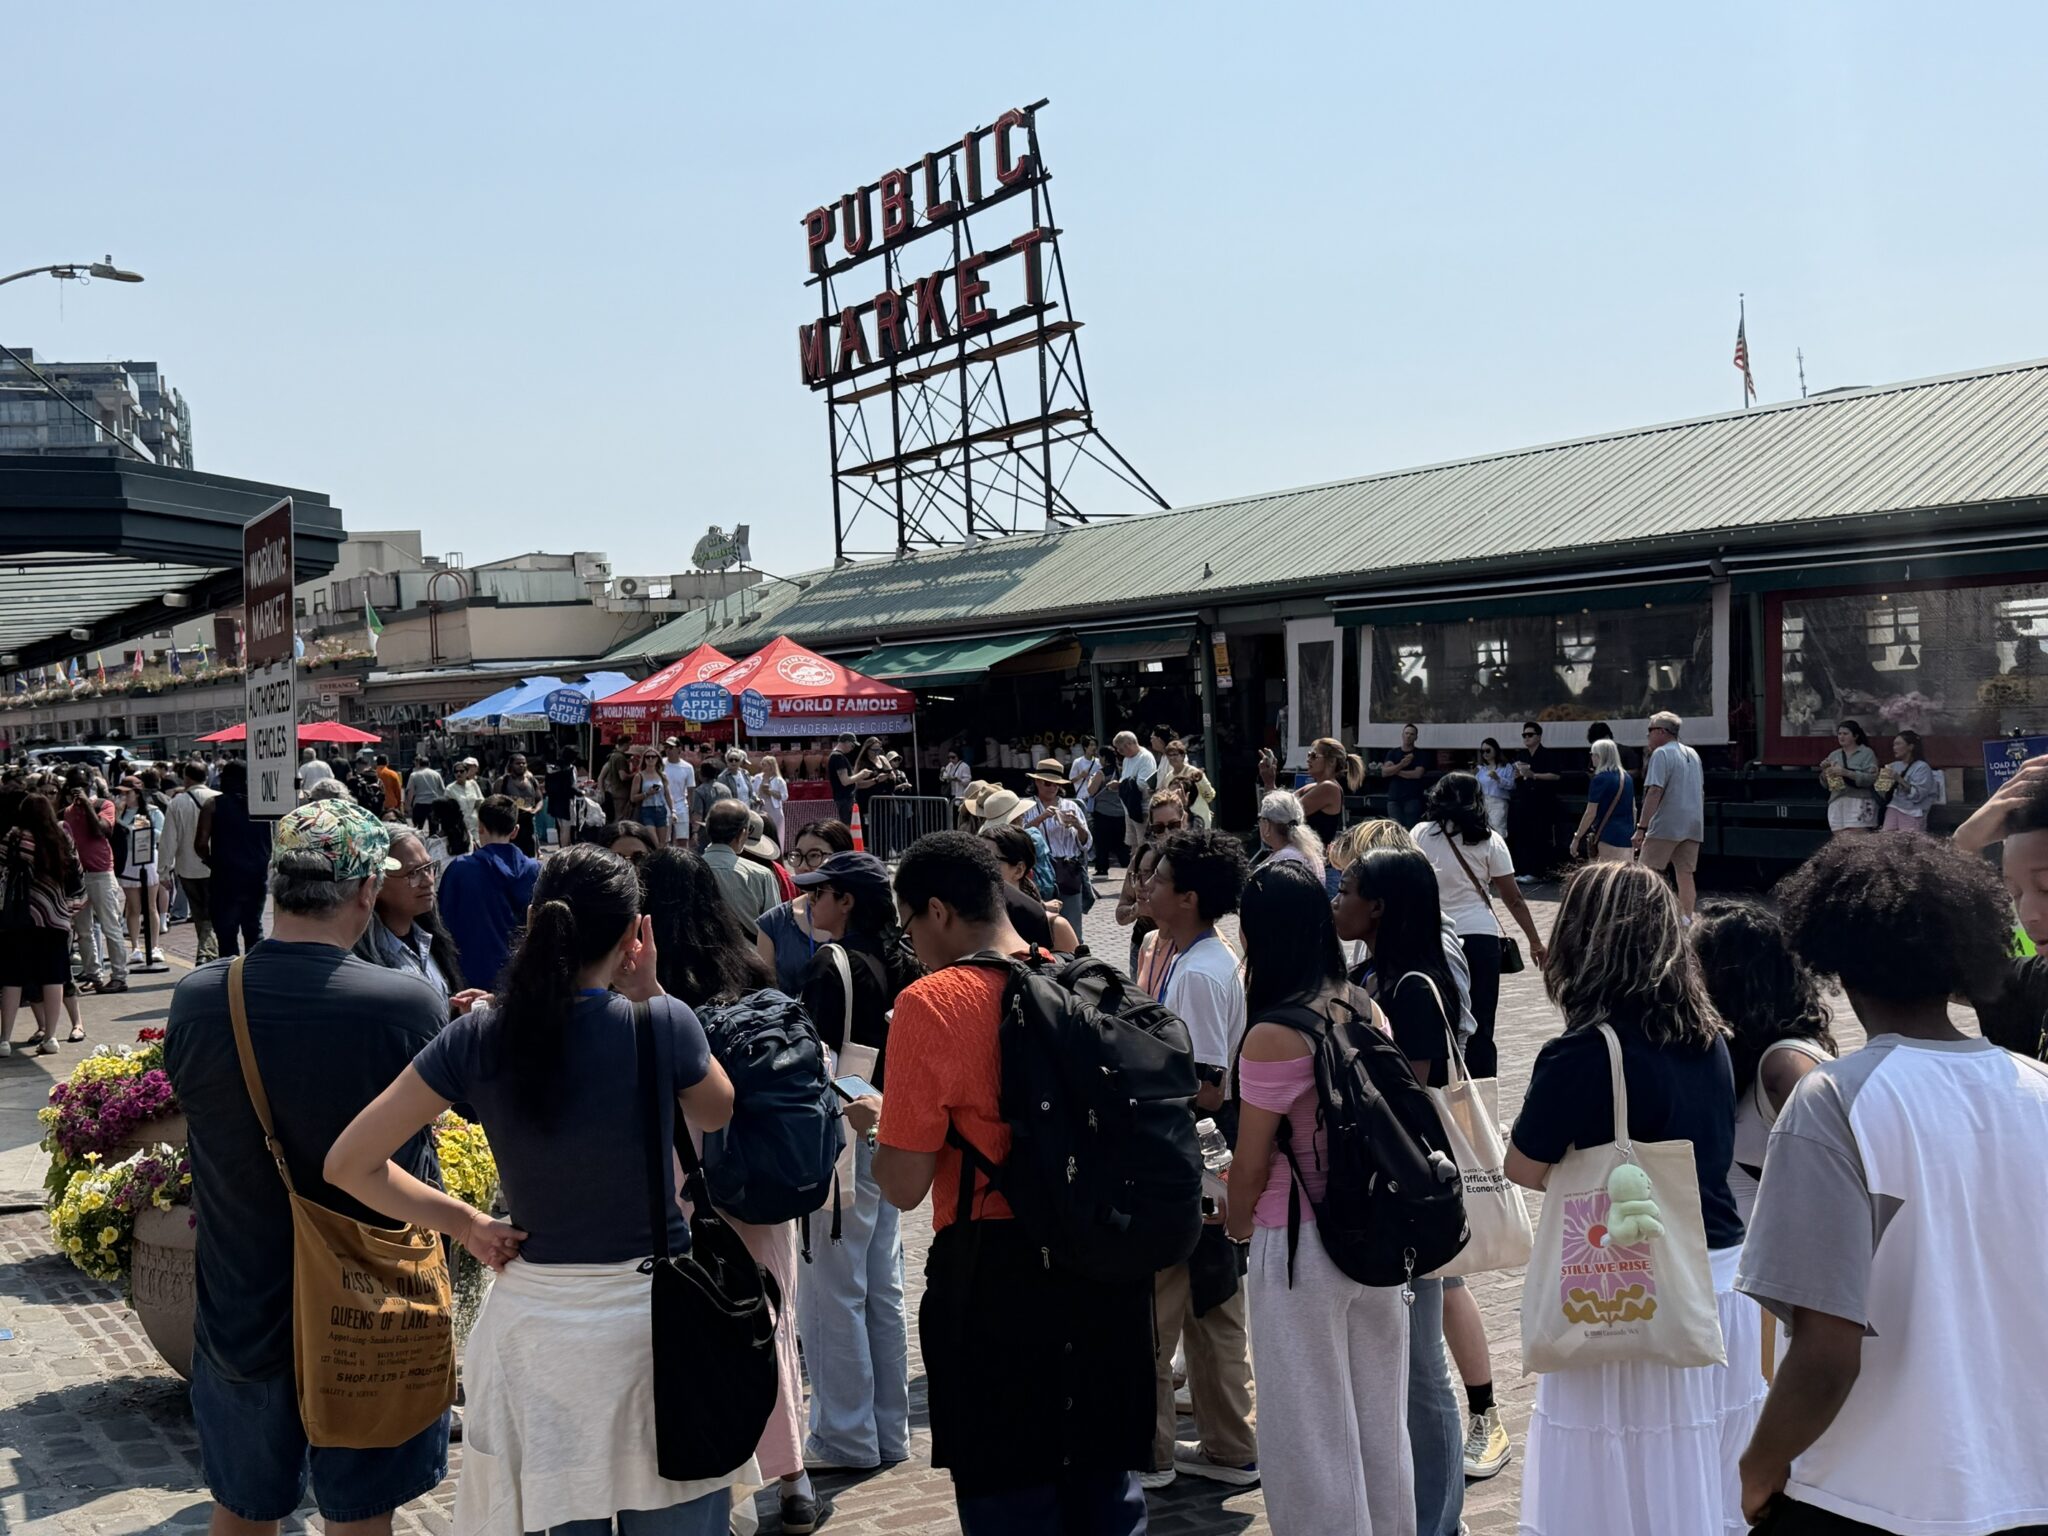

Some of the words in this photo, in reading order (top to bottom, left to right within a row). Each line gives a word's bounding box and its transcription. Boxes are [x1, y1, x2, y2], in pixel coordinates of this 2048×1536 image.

[804, 107, 1033, 274] PUBLIC
[798, 227, 1055, 385] MARKET
[250, 537, 286, 590] WORKING
[252, 593, 285, 642] MARKET
[249, 679, 290, 720] AUTHORIZED
[681, 700, 727, 709] APPLE
[778, 698, 833, 713] WORLD
[836, 698, 898, 711] FAMOUS
[550, 703, 587, 717] APPLE
[602, 706, 623, 719] WORLD
[681, 709, 728, 720] CIDER
[742, 704, 765, 720] APPLE
[549, 711, 585, 725] CIDER
[742, 714, 765, 729] CIDER
[773, 722, 828, 735] LAVENDER
[832, 721, 865, 733] APPLE
[870, 720, 901, 732] CIDER
[253, 725, 287, 760] VEHICLES
[1989, 761, 2010, 770] LOAD
[261, 771, 279, 802] ONLY
[1463, 1174, 1488, 1183] Office
[1561, 1264, 1594, 1276] STILL
[1593, 1262, 1617, 1273] WE
[1619, 1260, 1651, 1272] RISE
[331, 1305, 375, 1330] QUEENS
[380, 1311, 396, 1331] OF
[401, 1309, 429, 1330] LAKE
[336, 1372, 366, 1383] SHOP
[367, 1373, 379, 1383] AT
